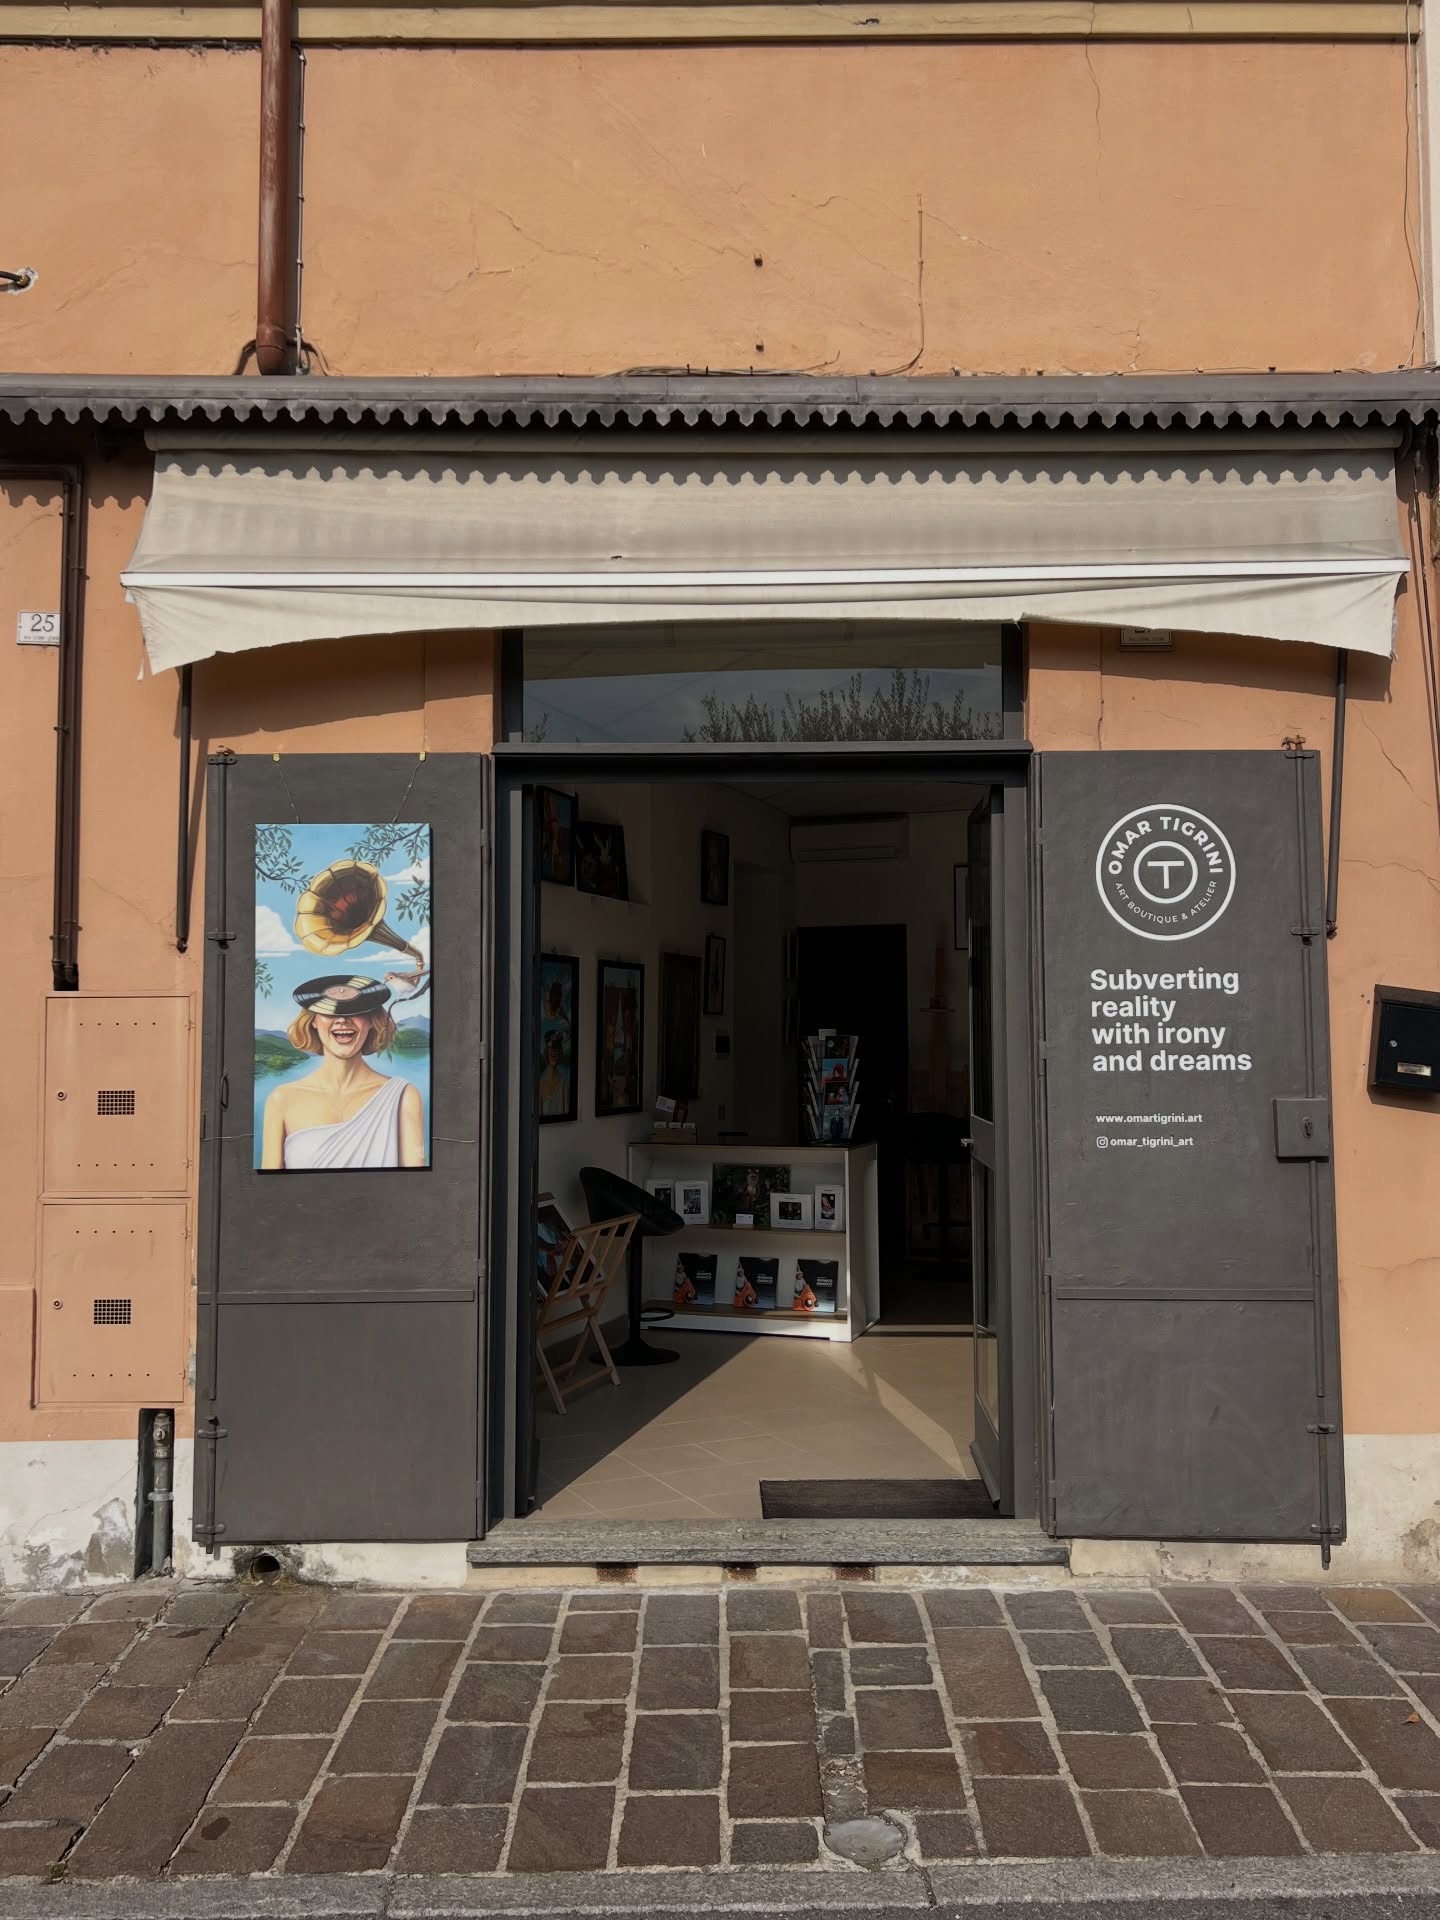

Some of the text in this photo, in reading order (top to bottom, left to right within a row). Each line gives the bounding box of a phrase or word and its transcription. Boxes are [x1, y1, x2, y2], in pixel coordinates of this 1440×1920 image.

[31, 614, 54, 632] 25
[1108, 816, 1224, 875] OMAR TIGRINI
[1115, 880, 1217, 924] ART BOUTIQUE & ATELIER
[1090, 966, 1239, 995] Subverting
[1091, 994, 1176, 1022] reality
[1091, 1021, 1226, 1049] with irony
[1092, 1049, 1252, 1072] and dreams
[1095, 1112, 1203, 1125] www.omartigrini.art
[1110, 1136, 1194, 1148] omar_tigrini_art
